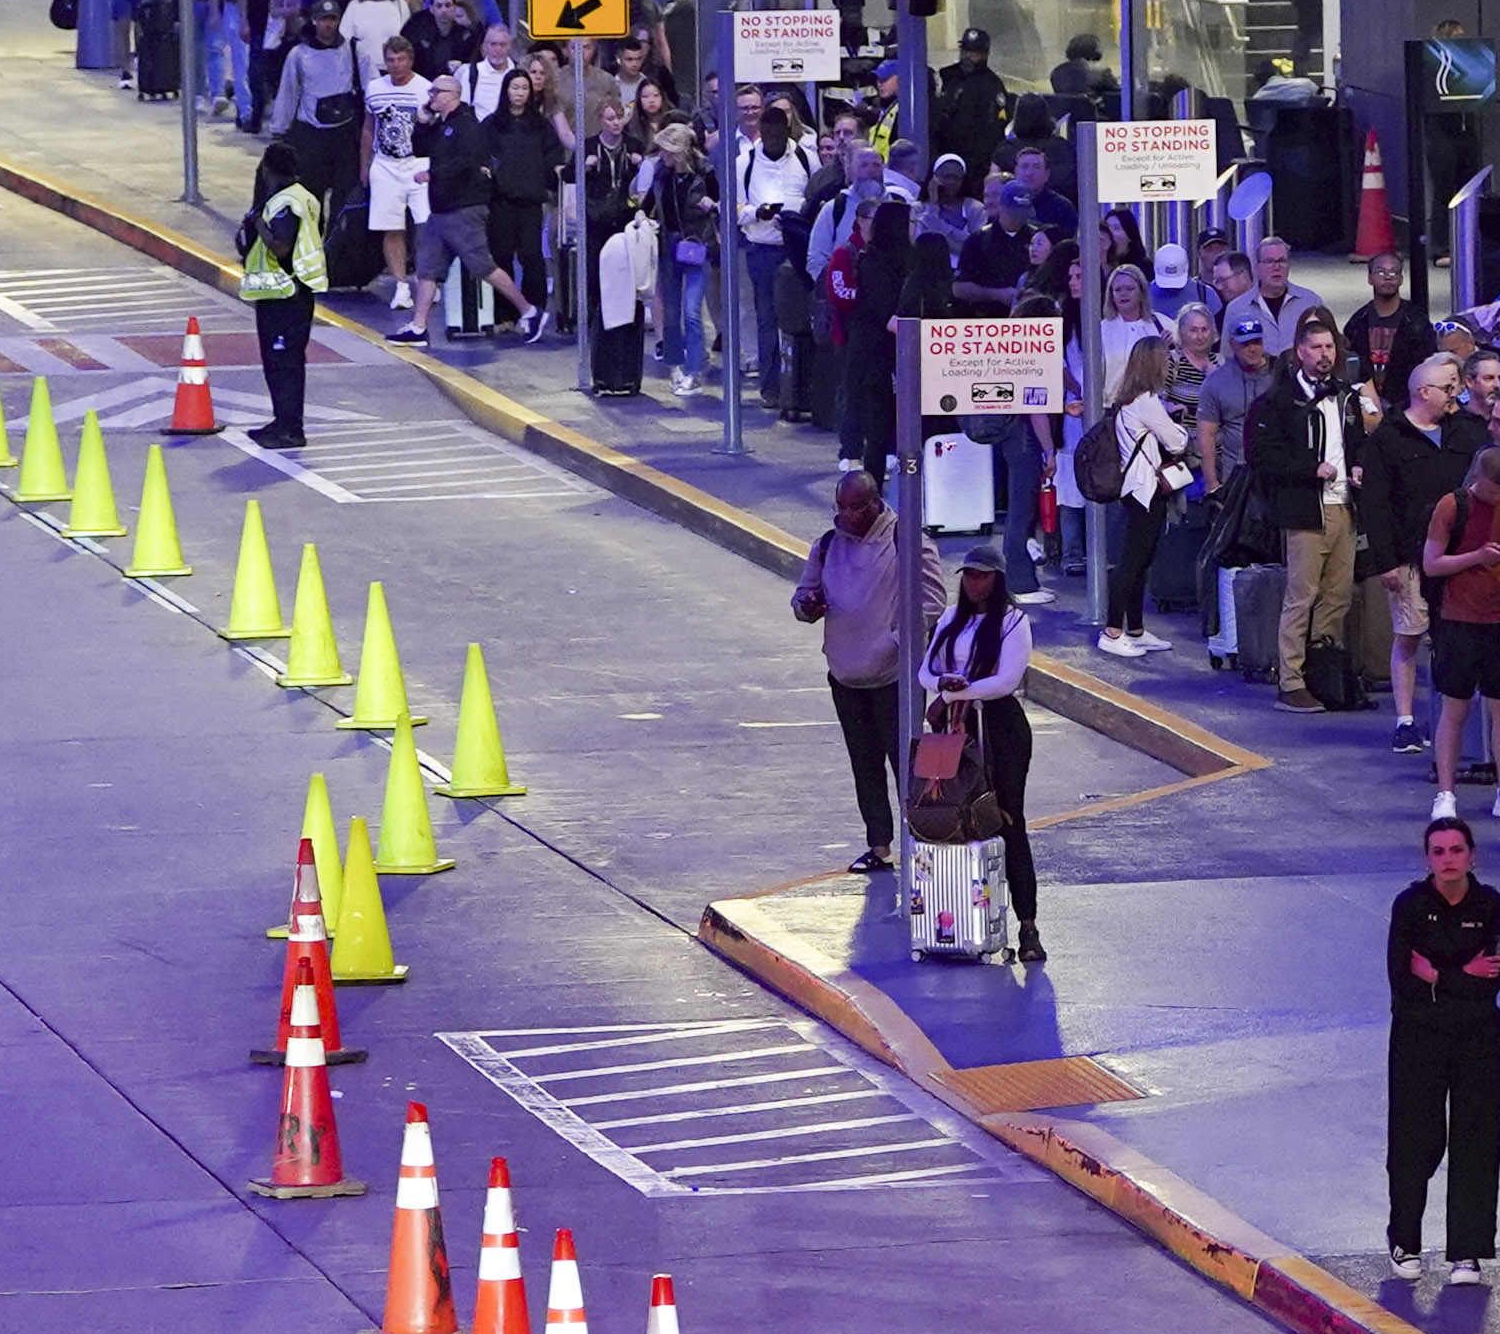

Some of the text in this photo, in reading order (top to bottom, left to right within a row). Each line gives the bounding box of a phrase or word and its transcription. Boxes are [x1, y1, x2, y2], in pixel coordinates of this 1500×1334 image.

[741, 15, 834, 26] NO STOPPING
[740, 27, 835, 39] OR STANDING
[1105, 125, 1209, 139] NO STOPPING
[1104, 139, 1210, 153] OR STANDING
[931, 323, 1055, 338] NO STOPPING
[930, 340, 1056, 355] OR STANDING
[949, 357, 1036, 367] Except for Active
[942, 368, 982, 378] Loading
[993, 368, 1044, 377] Unloading
[906, 458, 918, 474] 3
